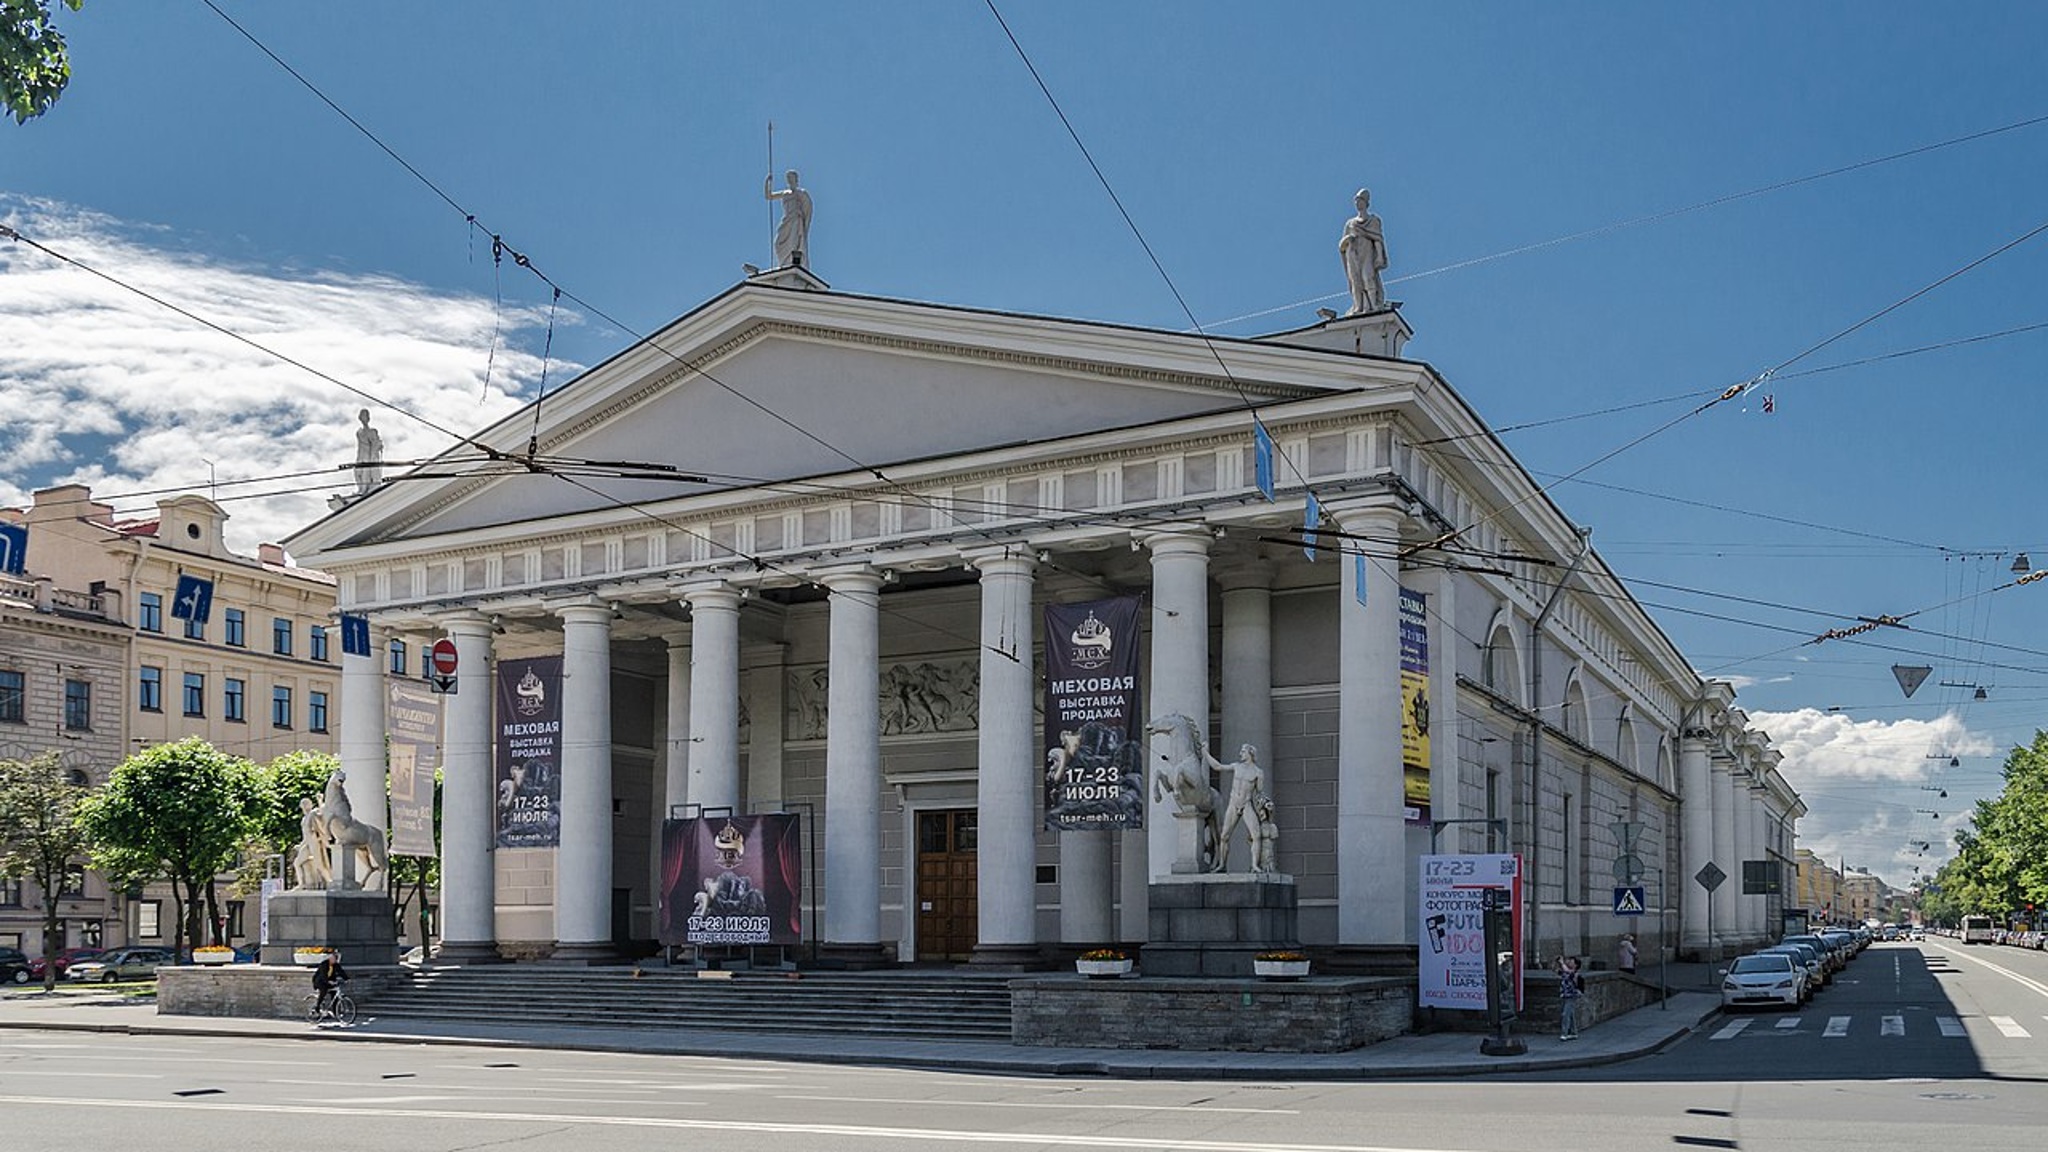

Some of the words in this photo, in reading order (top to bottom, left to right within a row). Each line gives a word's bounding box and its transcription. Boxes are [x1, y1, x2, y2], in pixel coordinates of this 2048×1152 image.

[1052, 676, 1134, 695] МЕХОВАЯ
[1059, 695, 1125, 709] ВЫСТАВКА
[1061, 708, 1122, 721] ПРОДАЖА
[503, 721, 559, 736] МЕХОВАЯ
[510, 737, 554, 748] ВЫСТАВКА
[511, 748, 552, 758] ПРОДАЖА
[1066, 766, 1119, 783] 17-23
[1066, 785, 1119, 800] ИЮЛЯ
[513, 795, 550, 809] 17-23
[513, 810, 549, 823] ИЮЛЯ
[1060, 812, 1126, 823] tsar-meh.ru
[1426, 861, 1475, 876] 17-23
[1426, 891, 1465, 899] КОНКУРС
[687, 916, 724, 931] 17-23
[725, 916, 770, 932] ИЮЛЯ
